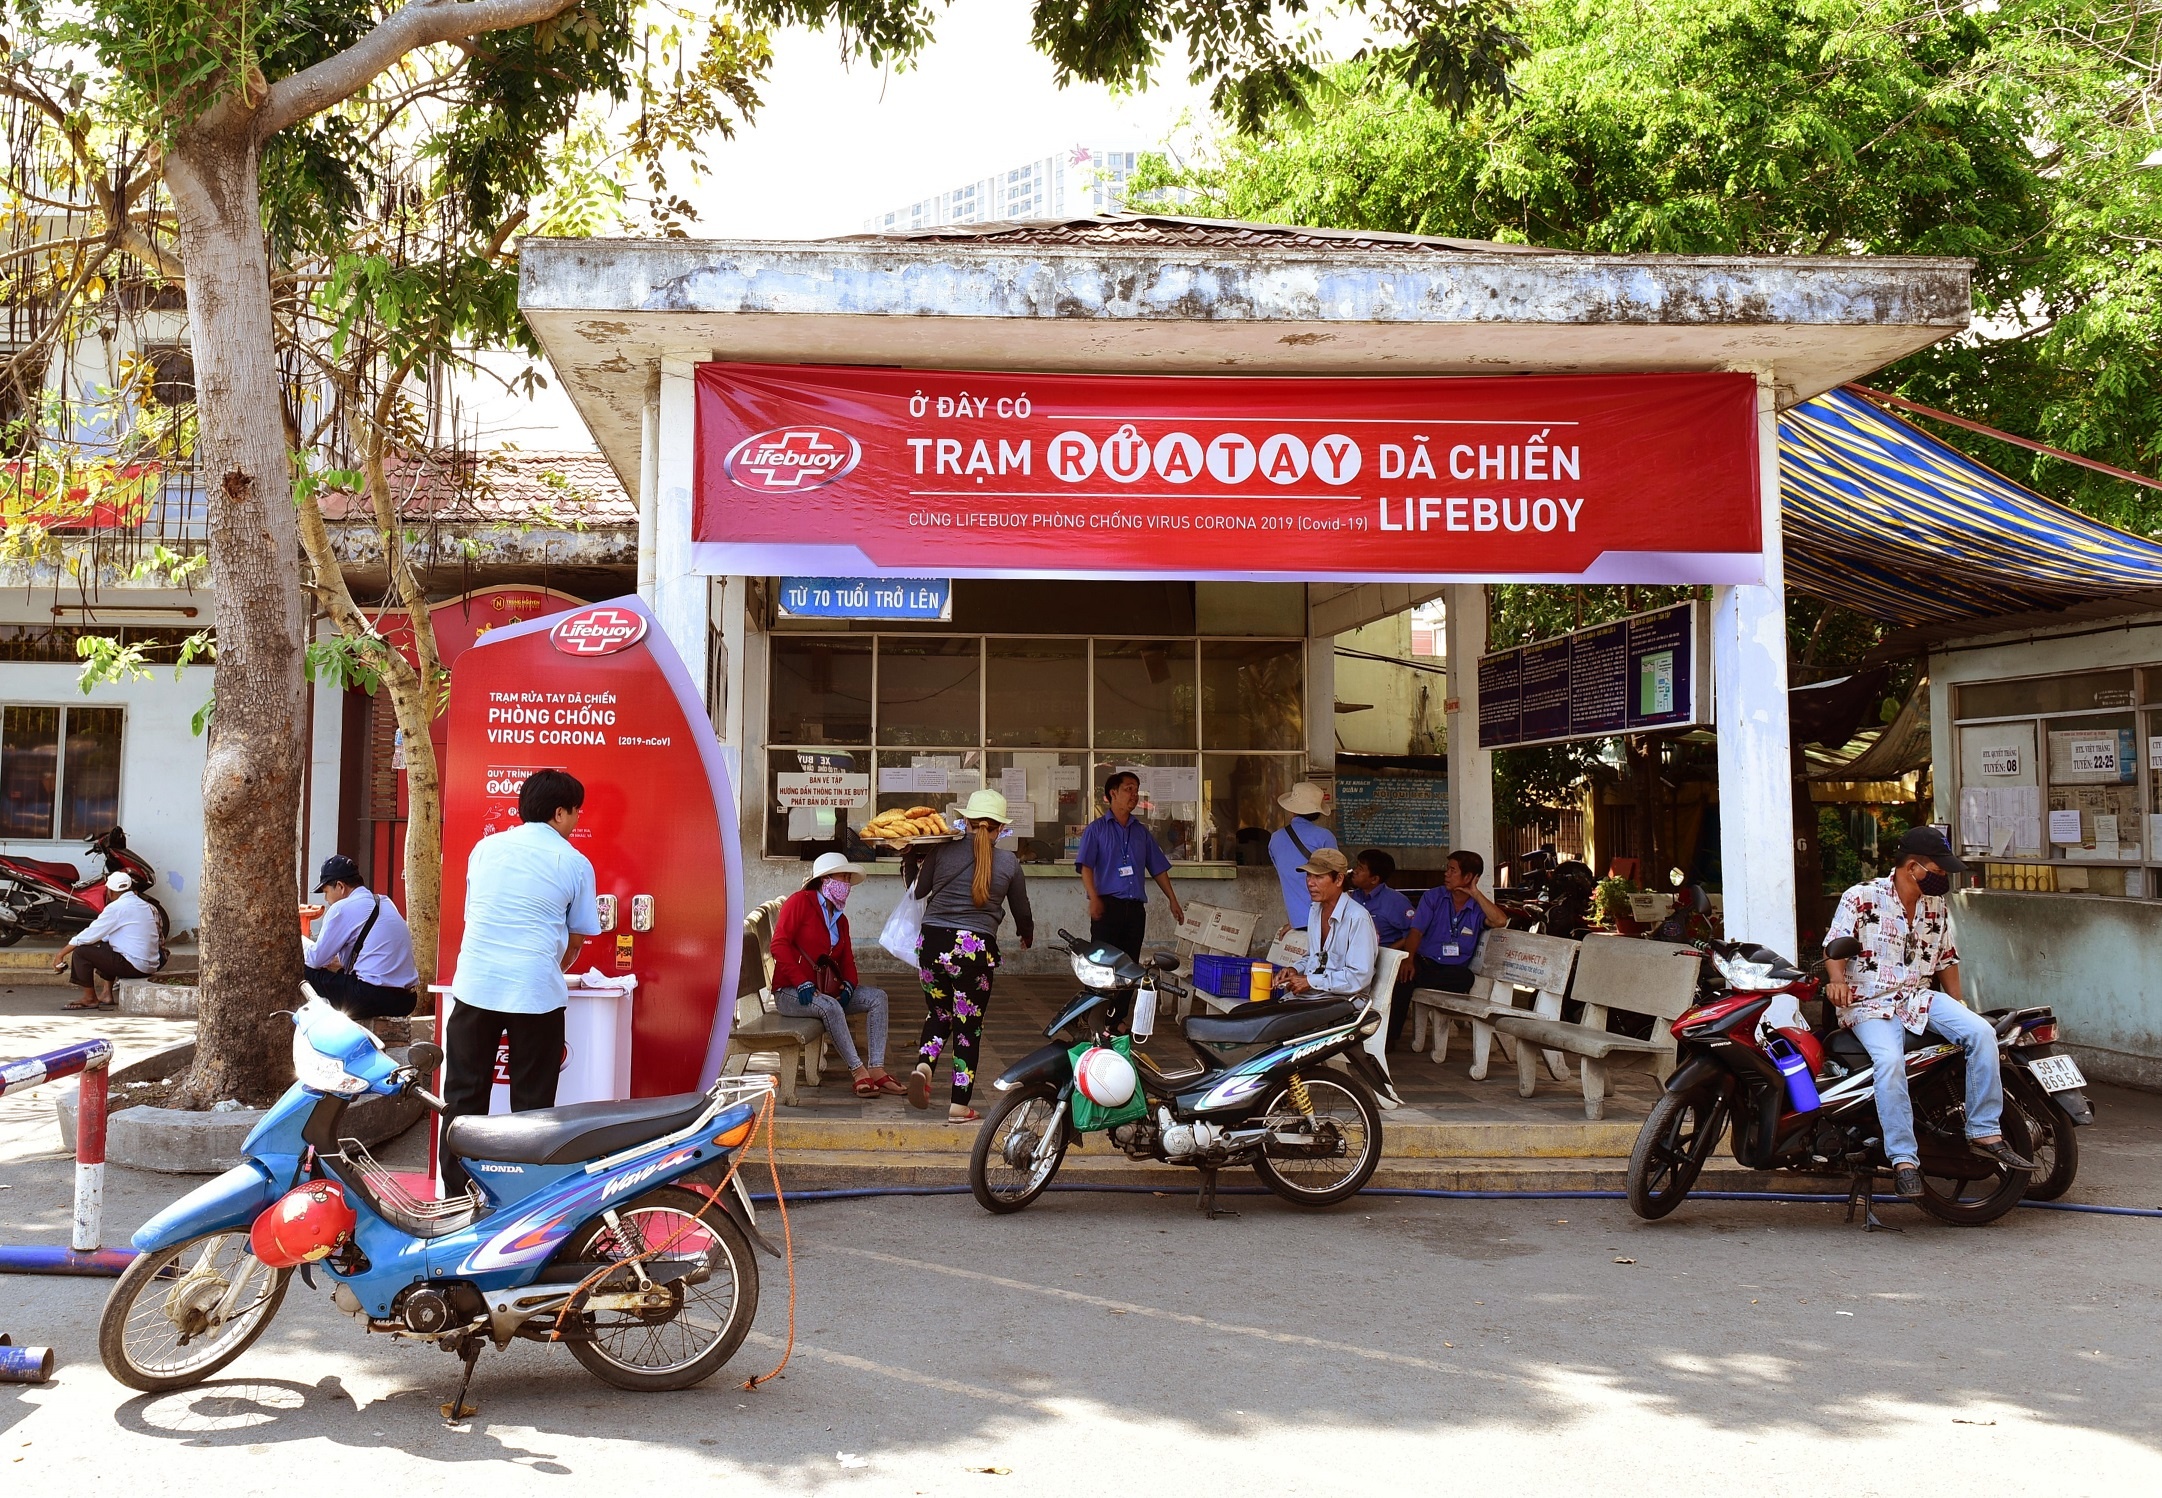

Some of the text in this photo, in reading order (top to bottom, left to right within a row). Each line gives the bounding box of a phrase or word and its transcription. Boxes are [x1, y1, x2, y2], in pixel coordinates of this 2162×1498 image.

[909, 389, 1032, 419] Ở ĐÂY CÓ
[738, 445, 847, 471] Lifebuoy
[907, 438, 1031, 484] TRẠM
[1379, 434, 1437, 480] DÃ
[1448, 428, 1581, 482] CHIẾN
[909, 509, 1369, 533] CÙNG LIFEBUOY PHÒNG CHỐNG VIRUS CORONA 2019 (Covid-19)
[1379, 496, 1584, 532] LIFEBUOY
[789, 582, 939, 609] TỪ 70 TUỔI TRỞ LÊN
[559, 623, 637, 638] Lifebuoy
[489, 690, 617, 704] TRẠM RỬA TAY DÃ CHIẾN
[488, 704, 616, 725] PHÒNG CHỐNG
[487, 729, 671, 747] VIRUS CORONA (2019-nCoV)
[2006, 759, 2017, 772] 08
[2093, 755, 2114, 769] 22-25
[487, 768, 533, 778] QUY TRÌNH
[830, 798, 838, 806] XE
[2042, 1072, 2082, 1090] 869.54
[481, 1164, 524, 1173] HONDA
